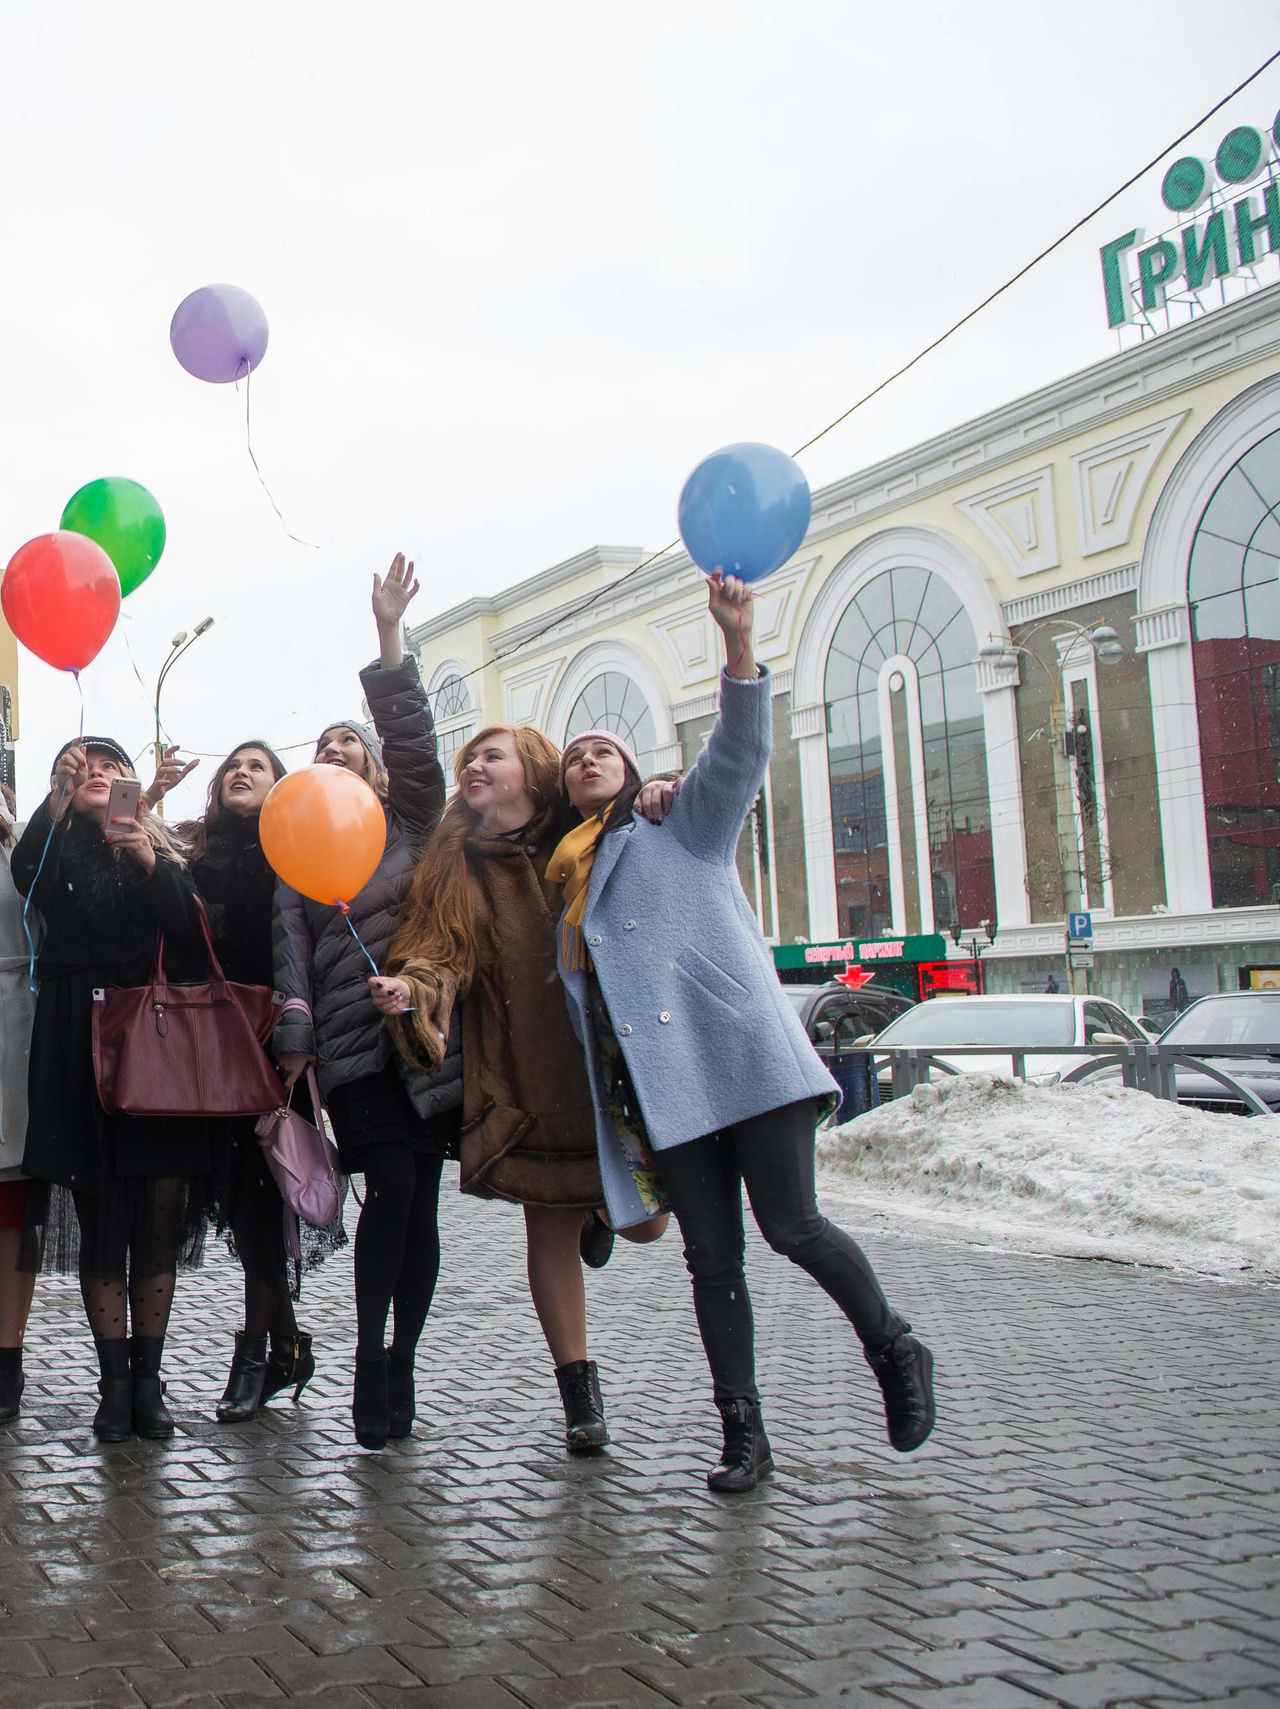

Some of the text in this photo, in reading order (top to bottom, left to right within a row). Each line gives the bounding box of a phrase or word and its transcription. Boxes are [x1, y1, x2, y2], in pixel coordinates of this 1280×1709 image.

[1074, 914, 1088, 936] P
[805, 940, 905, 964] СЕВЕРНЫЙ ПАРКИНГ
